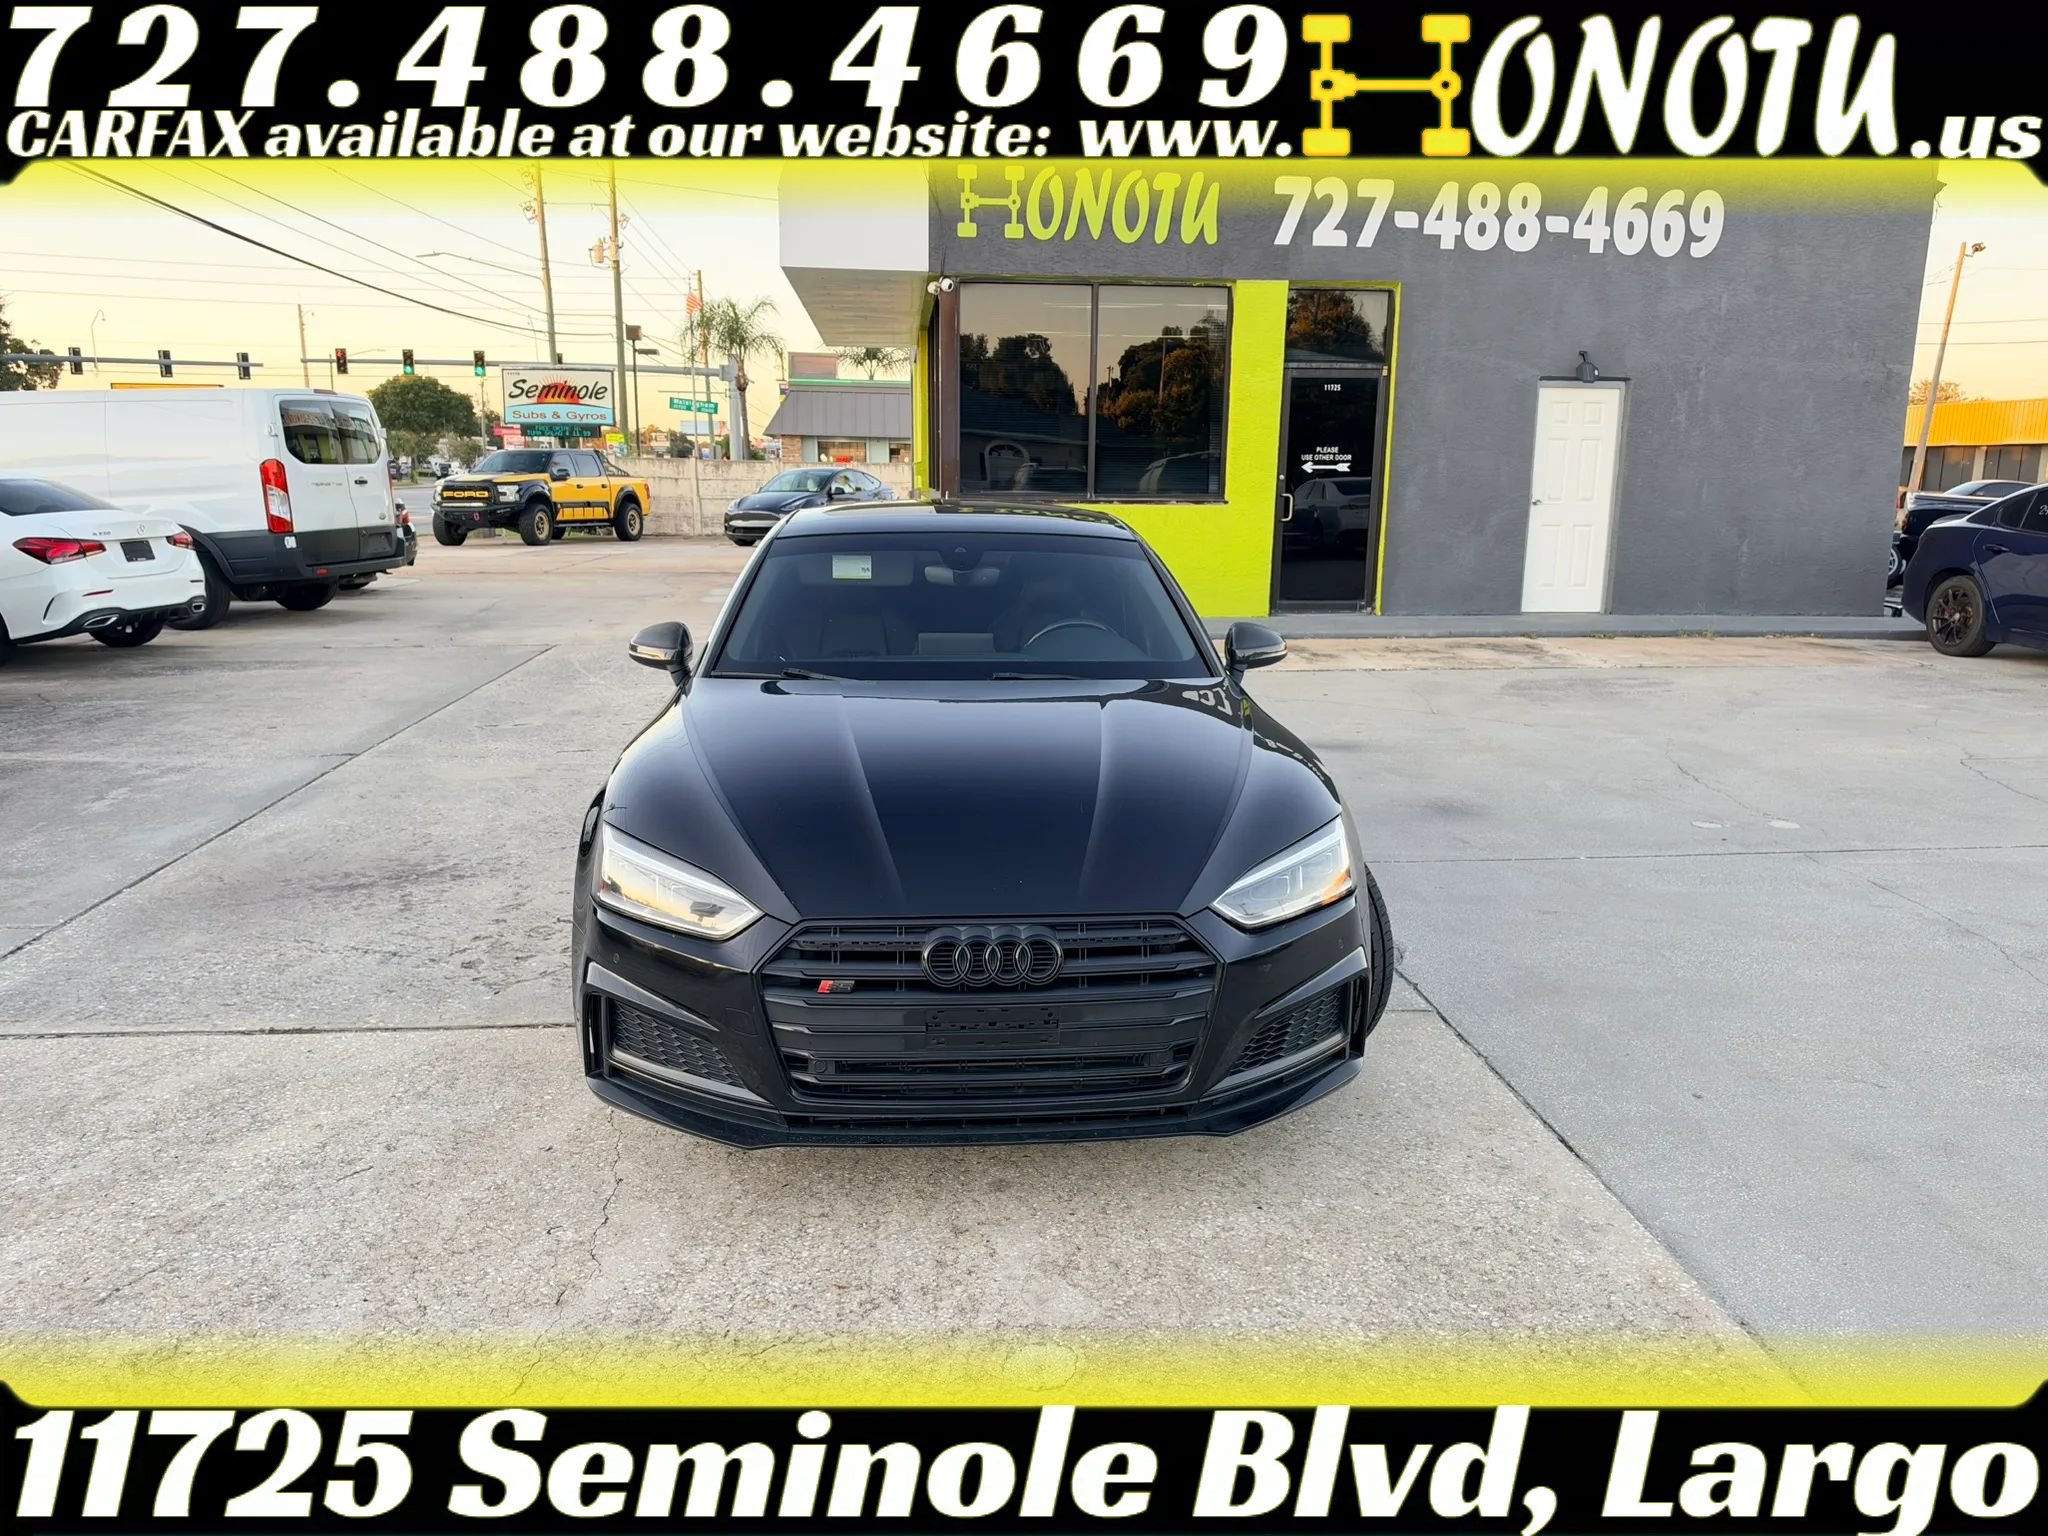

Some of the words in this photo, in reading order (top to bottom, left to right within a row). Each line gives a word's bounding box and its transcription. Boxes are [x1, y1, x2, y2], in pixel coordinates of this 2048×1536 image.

[1272, 175, 1726, 258] 727-488-4669
[508, 378, 608, 400] Seminole
[512, 410, 547, 420] Subs
[551, 411, 561, 419] &
[566, 411, 607, 422] Gyros
